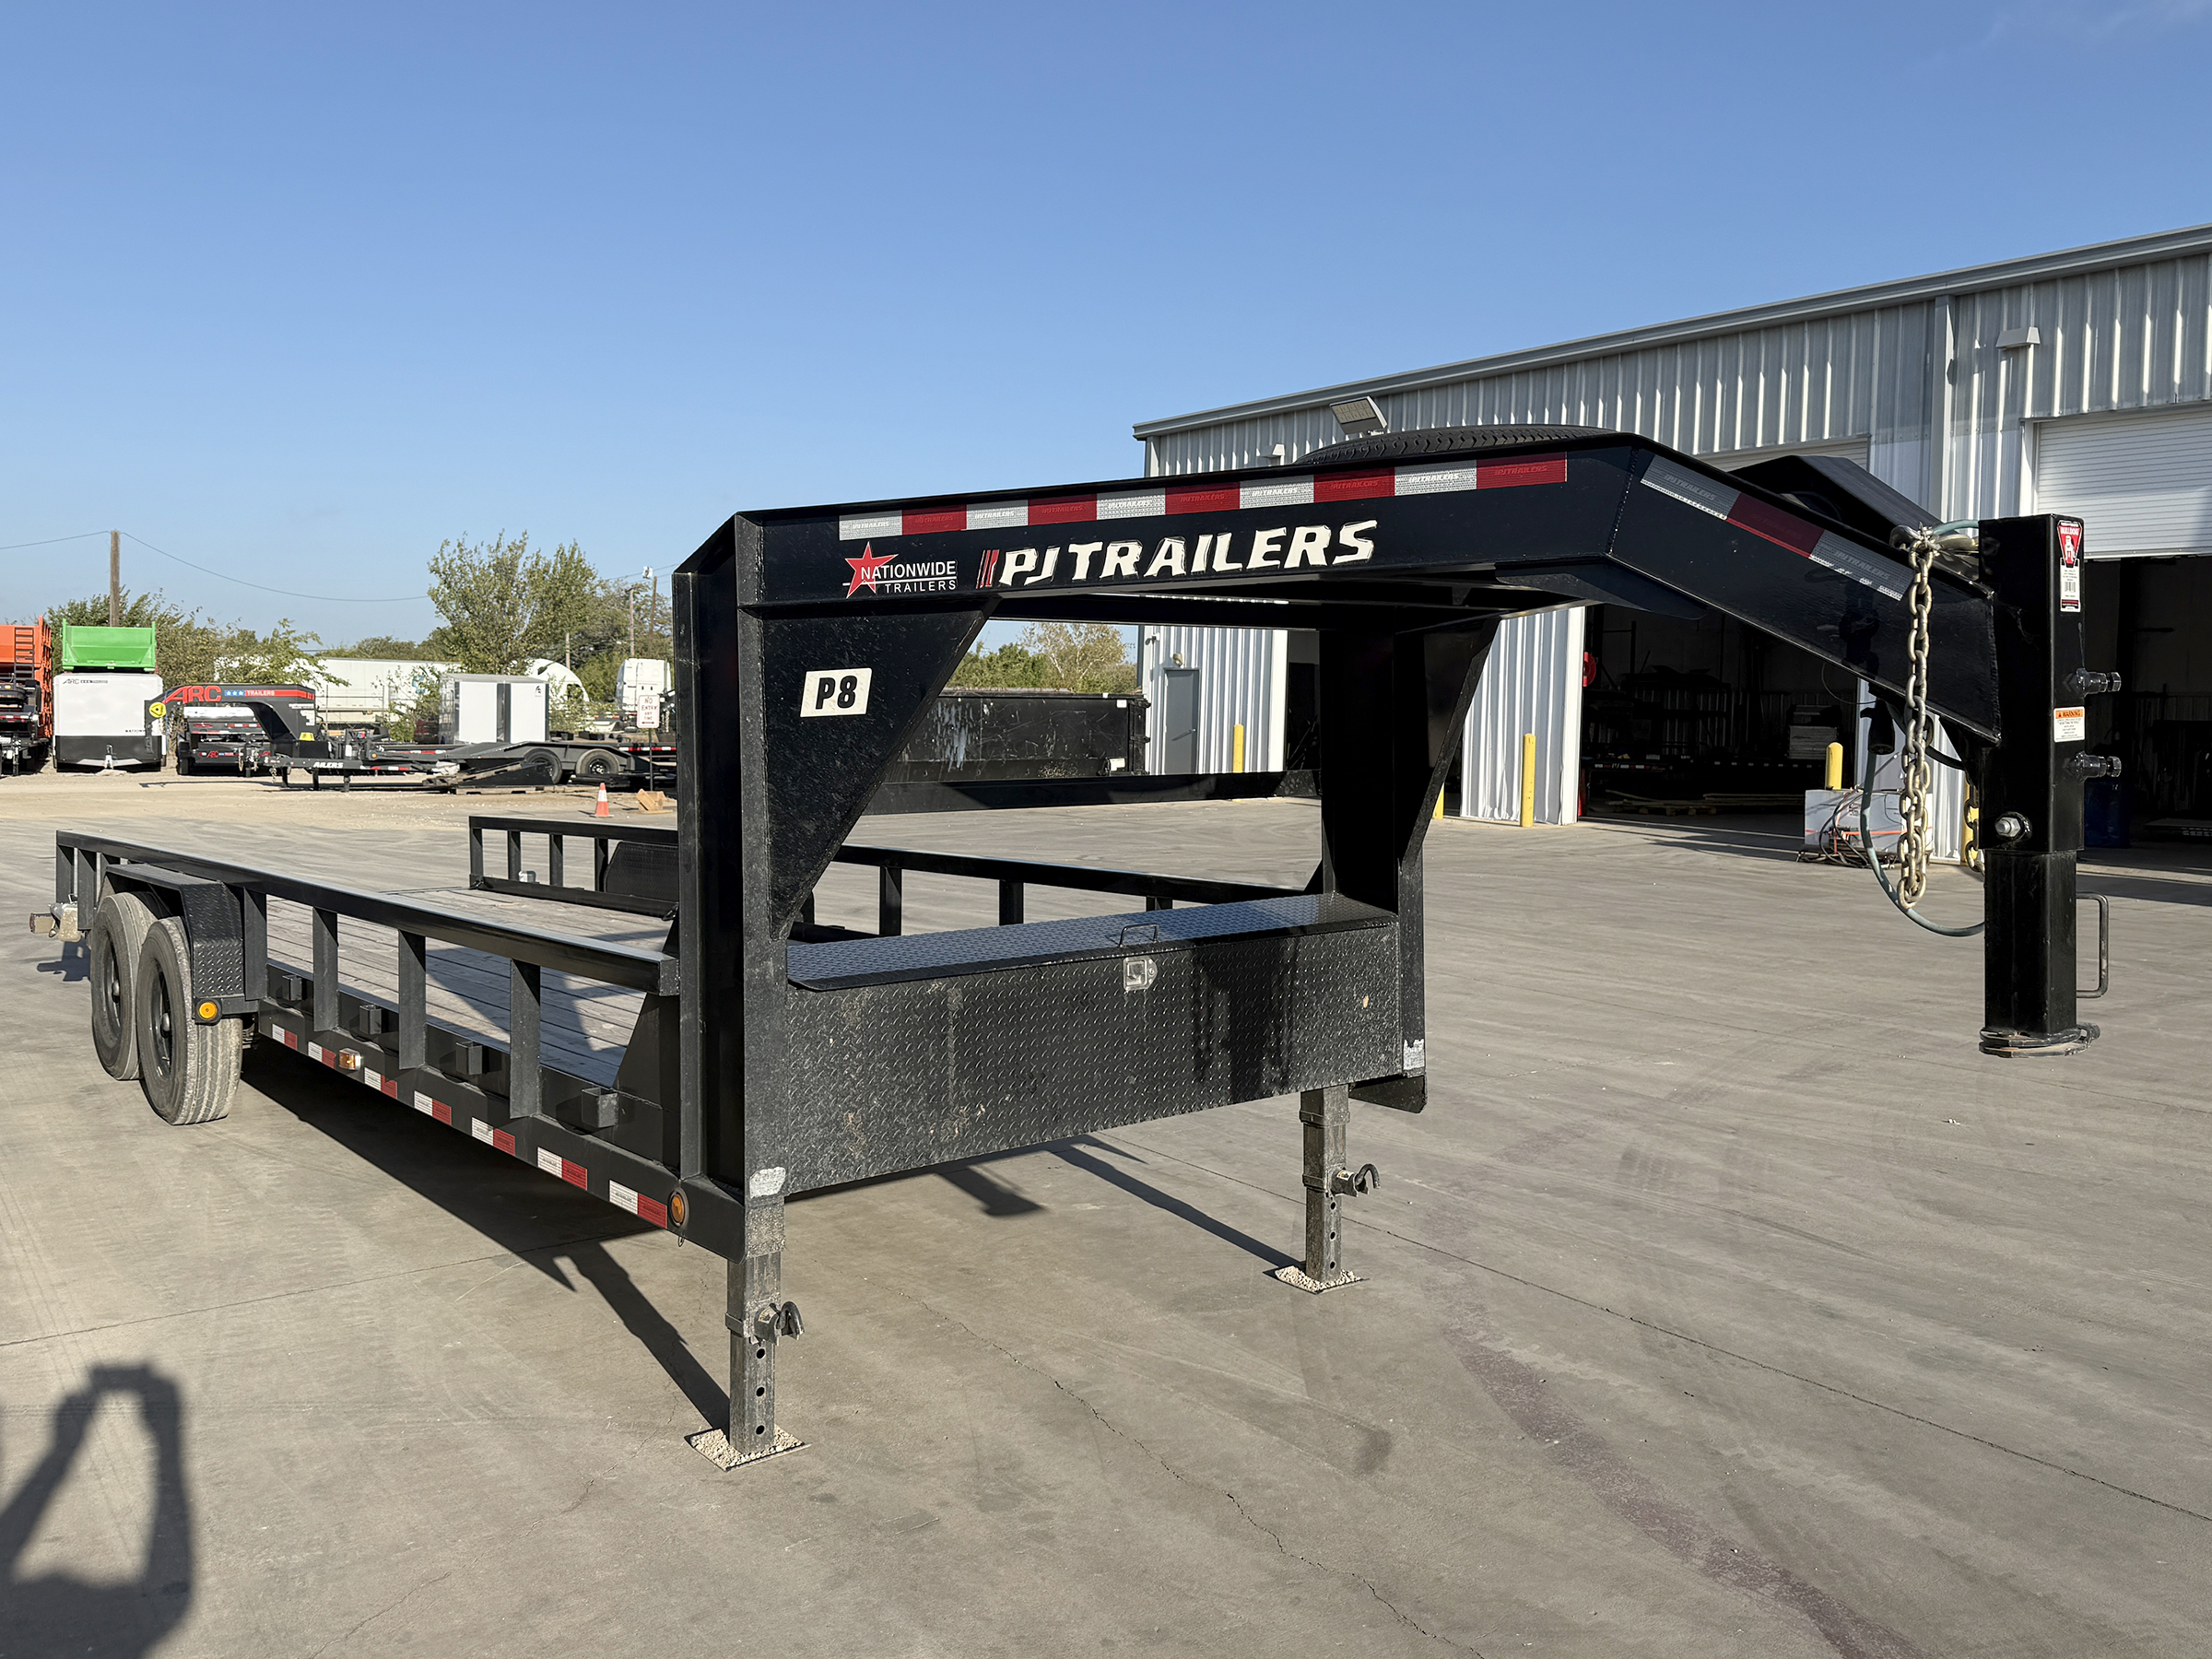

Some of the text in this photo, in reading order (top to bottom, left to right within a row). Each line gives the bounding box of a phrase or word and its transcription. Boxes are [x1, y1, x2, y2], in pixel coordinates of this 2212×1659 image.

[1067, 519, 1379, 582] TRAILERS
[861, 560, 957, 580] NATIONWIDE
[885, 580, 957, 594] TRAILERS
[162, 685, 222, 704] ARC
[815, 675, 858, 710] P8
